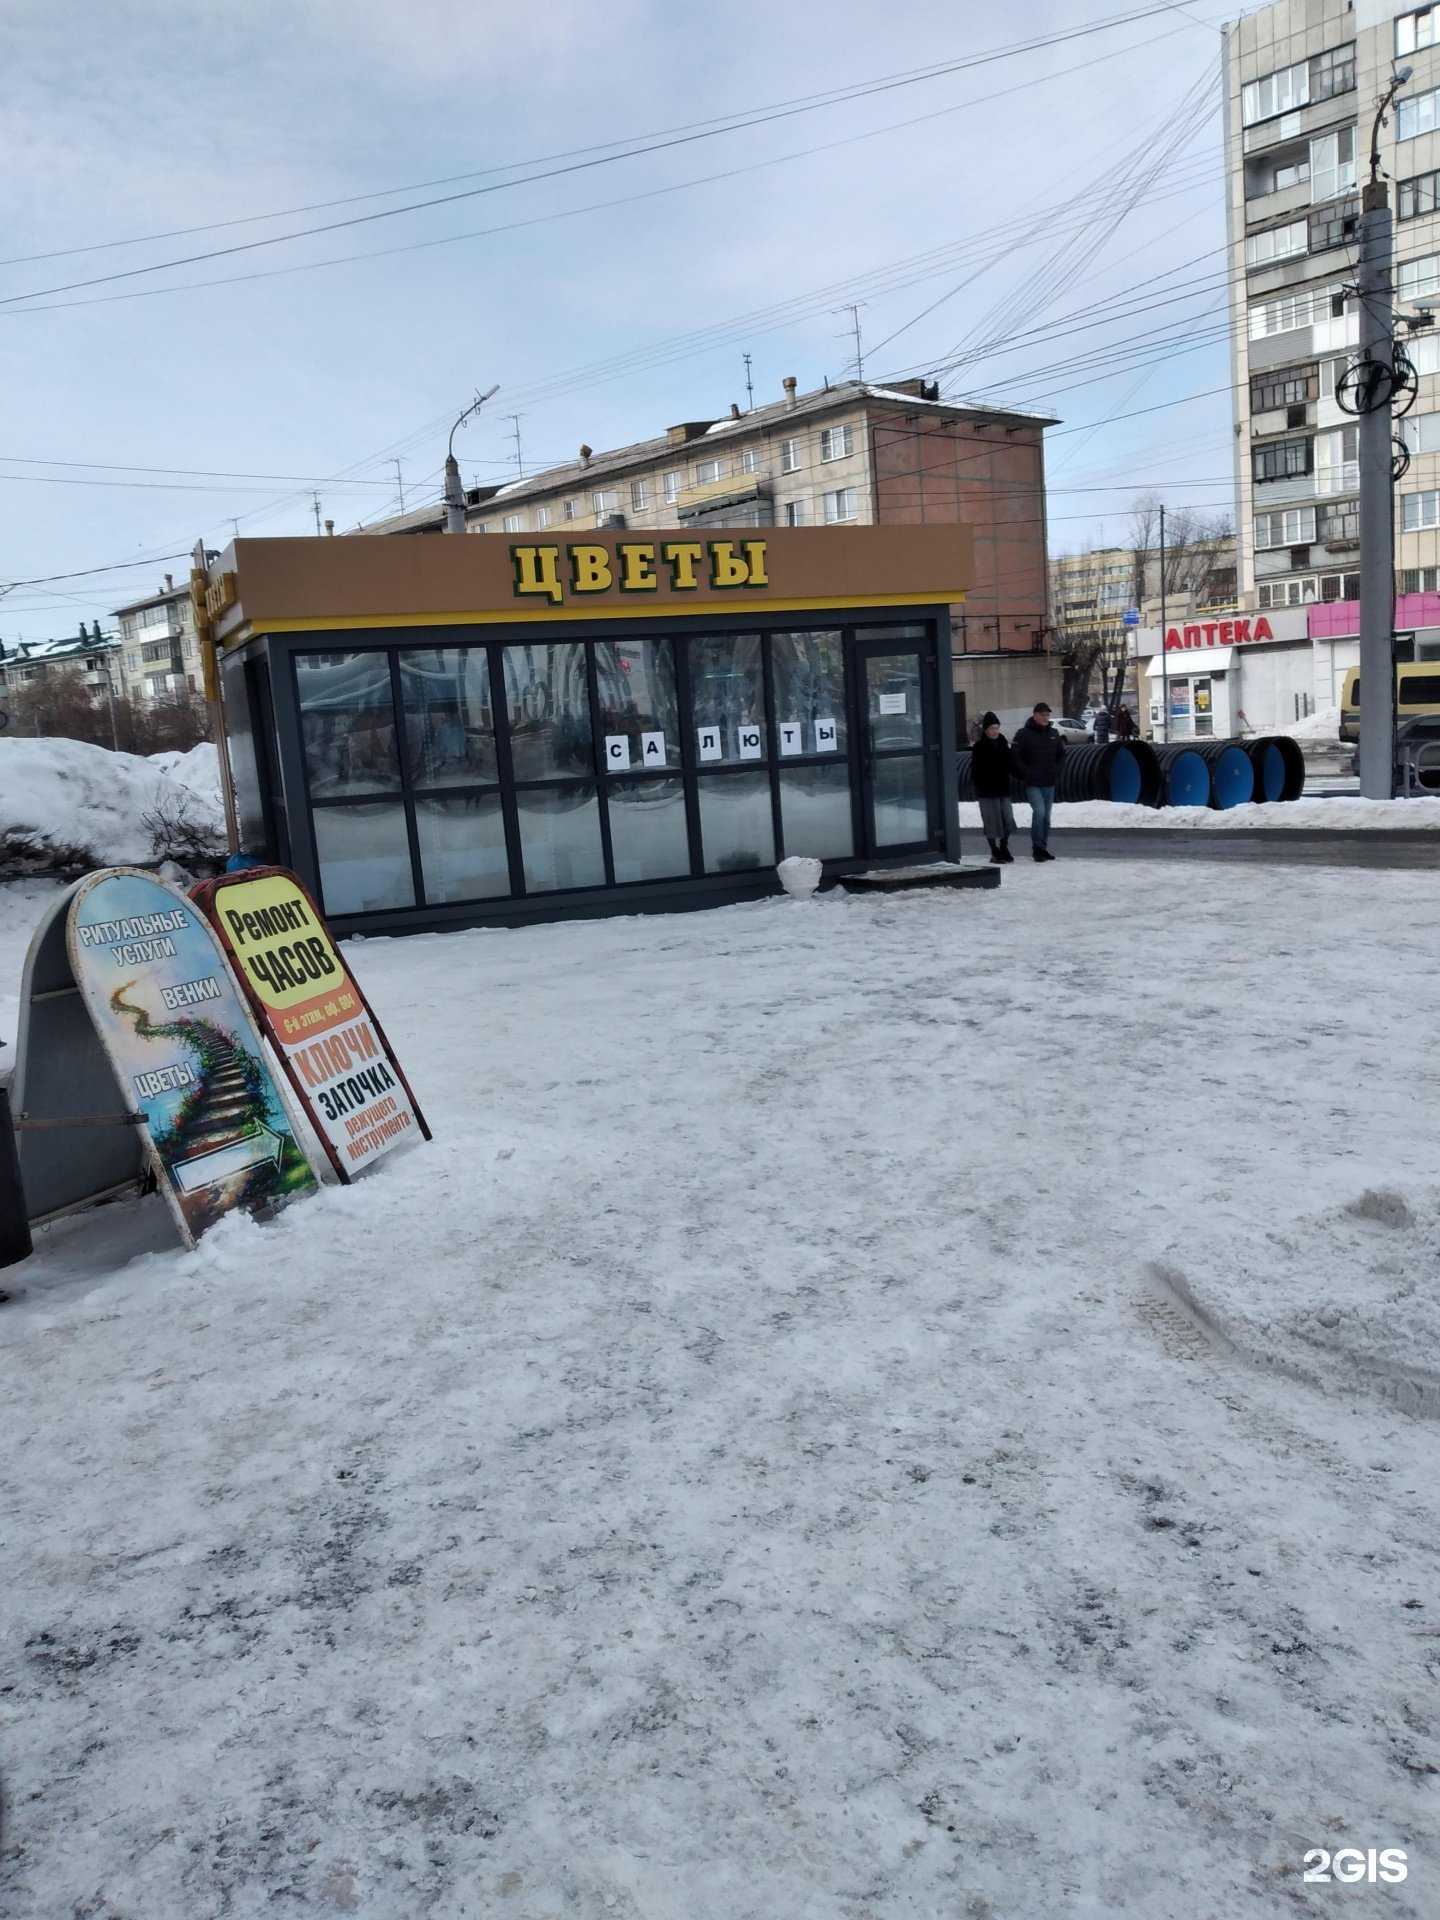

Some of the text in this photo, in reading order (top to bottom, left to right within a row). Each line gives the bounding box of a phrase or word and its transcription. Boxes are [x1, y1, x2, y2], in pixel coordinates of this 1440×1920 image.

[510, 540, 769, 607] ЦВЕТЫ
[1165, 617, 1274, 651] АПТЕКА
[610, 727, 834, 758] САЛЮТЫ
[78, 910, 189, 947] РИТУАЛЬНЫЕ
[224, 900, 310, 945] Ремонт
[112, 937, 177, 967] УСЛУГИ
[248, 936, 336, 994] ЧАСОВ
[160, 976, 222, 1010] ВЕНКИ
[294, 1021, 380, 1089] КЛЮЧИ
[134, 1062, 197, 1100] ЦВЕТЫ
[317, 1062, 396, 1121] ЗАТОЧКА
[344, 1096, 397, 1139] режущего
[346, 1110, 411, 1160] инструмента
